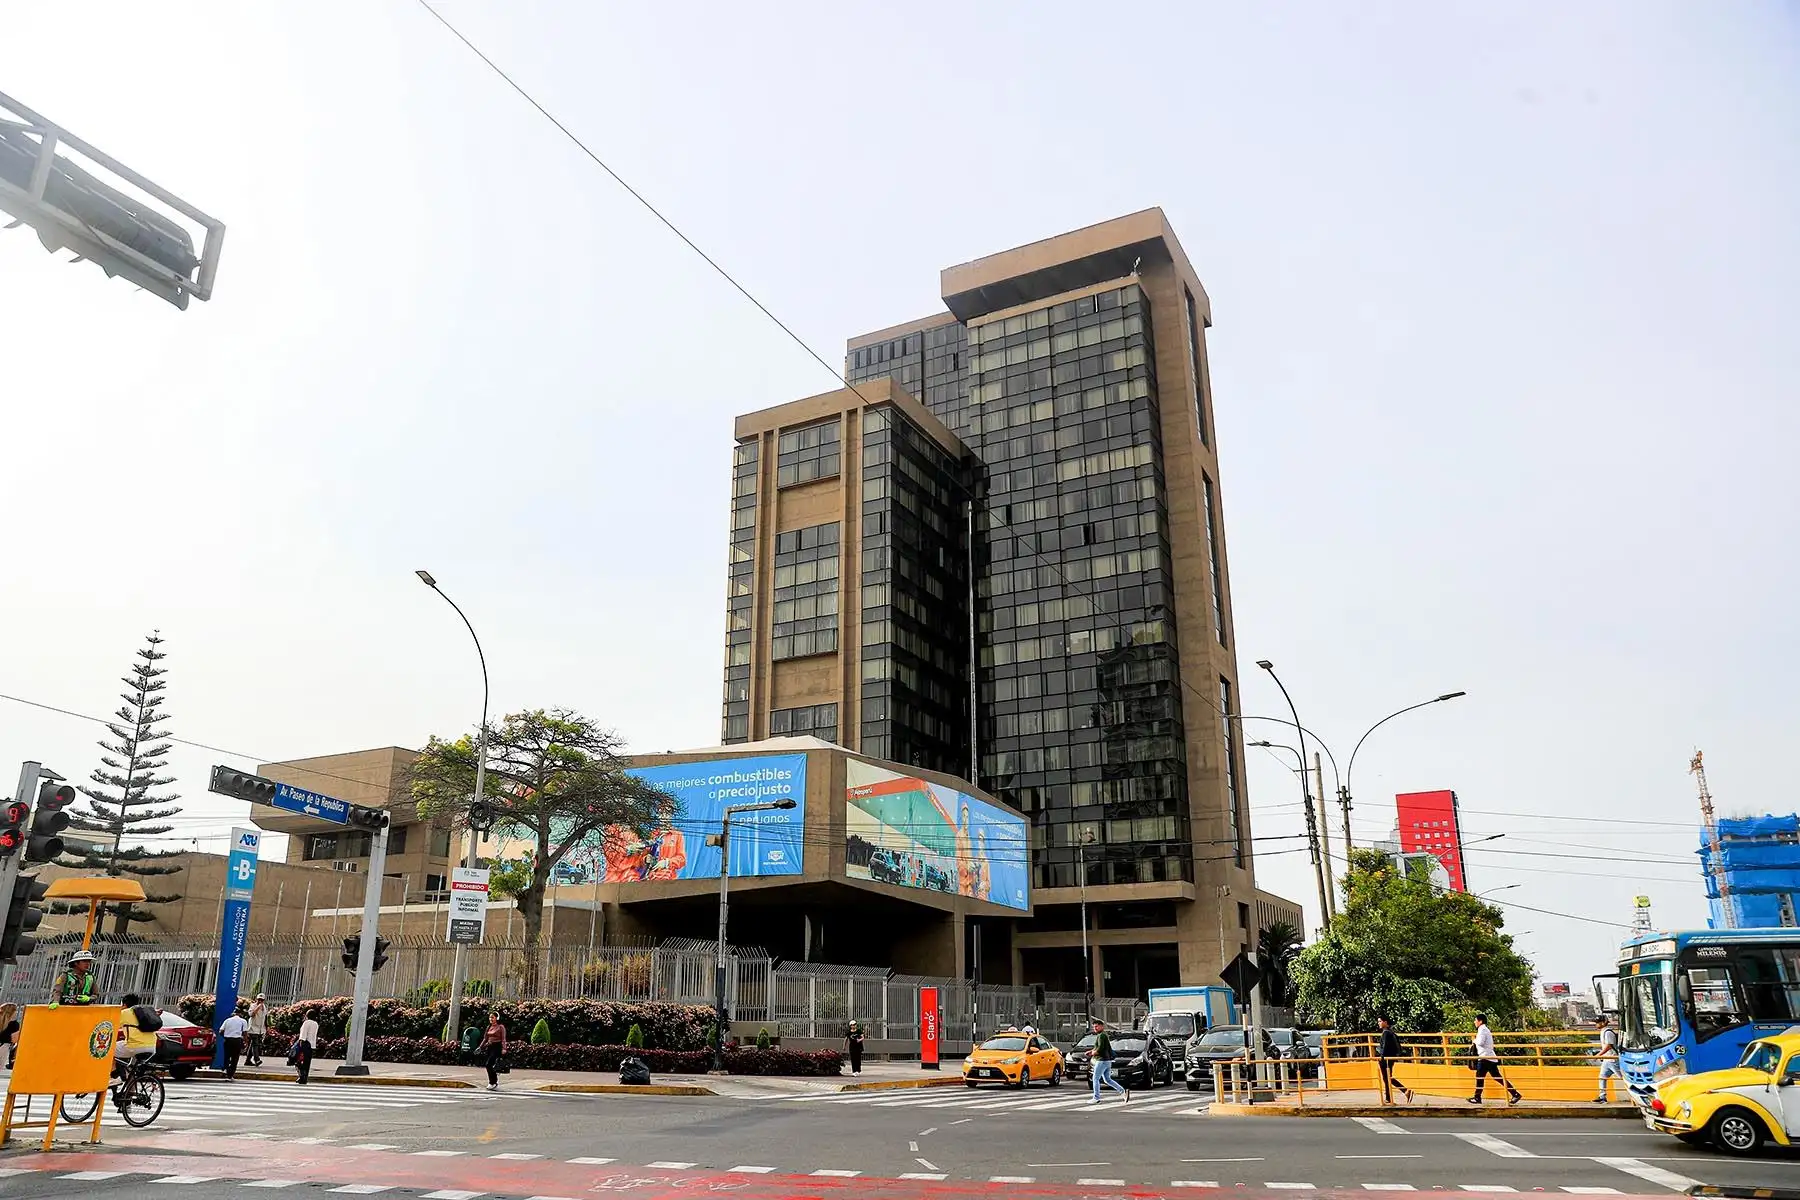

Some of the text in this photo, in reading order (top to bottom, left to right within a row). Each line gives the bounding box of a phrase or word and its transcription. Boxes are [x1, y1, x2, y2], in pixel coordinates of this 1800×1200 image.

[666, 778, 706, 791] mejores
[708, 767, 792, 785] combustibles
[289, 787, 306, 802] Paseo
[306, 793, 314, 804] de
[314, 795, 320, 806] la
[709, 783, 791, 801] a precio justo
[9, 808, 18, 822] 9
[739, 814, 790, 825] peruanos
[240, 833, 258, 846] ATU
[232, 906, 242, 940] ESTACIÓN
[230, 952, 241, 989] CANAVAL
[238, 908, 248, 946] MOREYRA
[926, 1014, 934, 1040] Claro
[1676, 1046, 1686, 1054] 29
